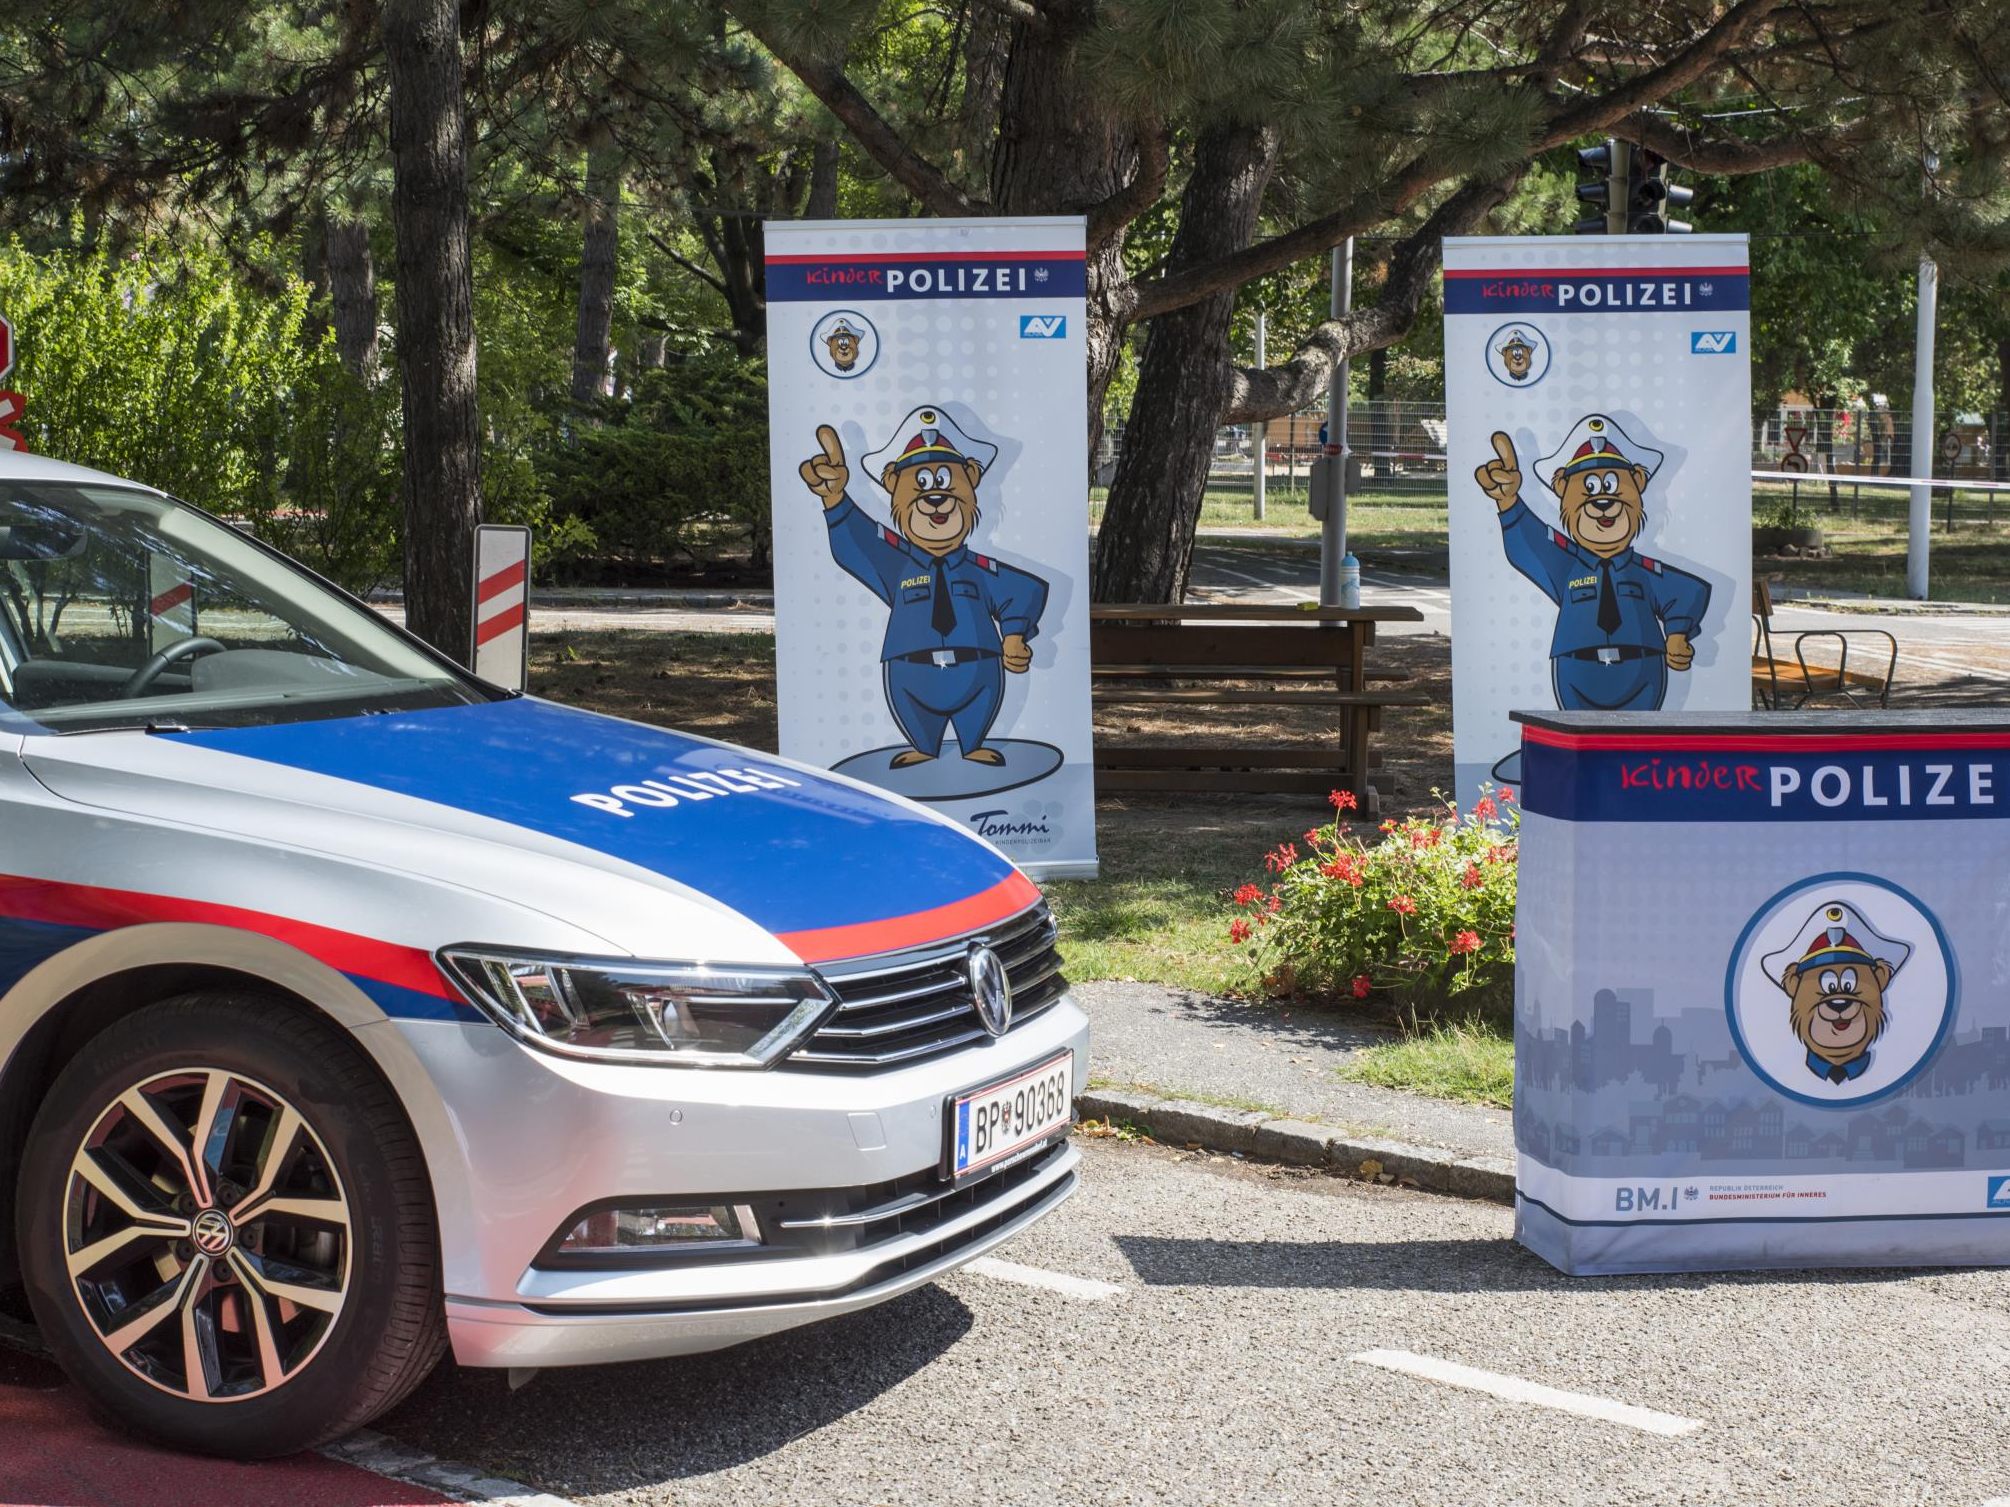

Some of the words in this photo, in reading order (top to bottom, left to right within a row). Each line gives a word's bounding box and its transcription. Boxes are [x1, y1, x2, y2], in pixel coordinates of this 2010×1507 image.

[886, 267, 1026, 293] POLIZEI
[1558, 283, 1691, 306] POLIZEI
[900, 576, 931, 590] POLIZEI
[1568, 576, 1598, 590] POLIZEI
[569, 767, 802, 818] POLIZEI
[970, 809, 1051, 837] Tommi
[975, 1101, 999, 1154] BP
[1015, 1070, 1065, 1137] 90368
